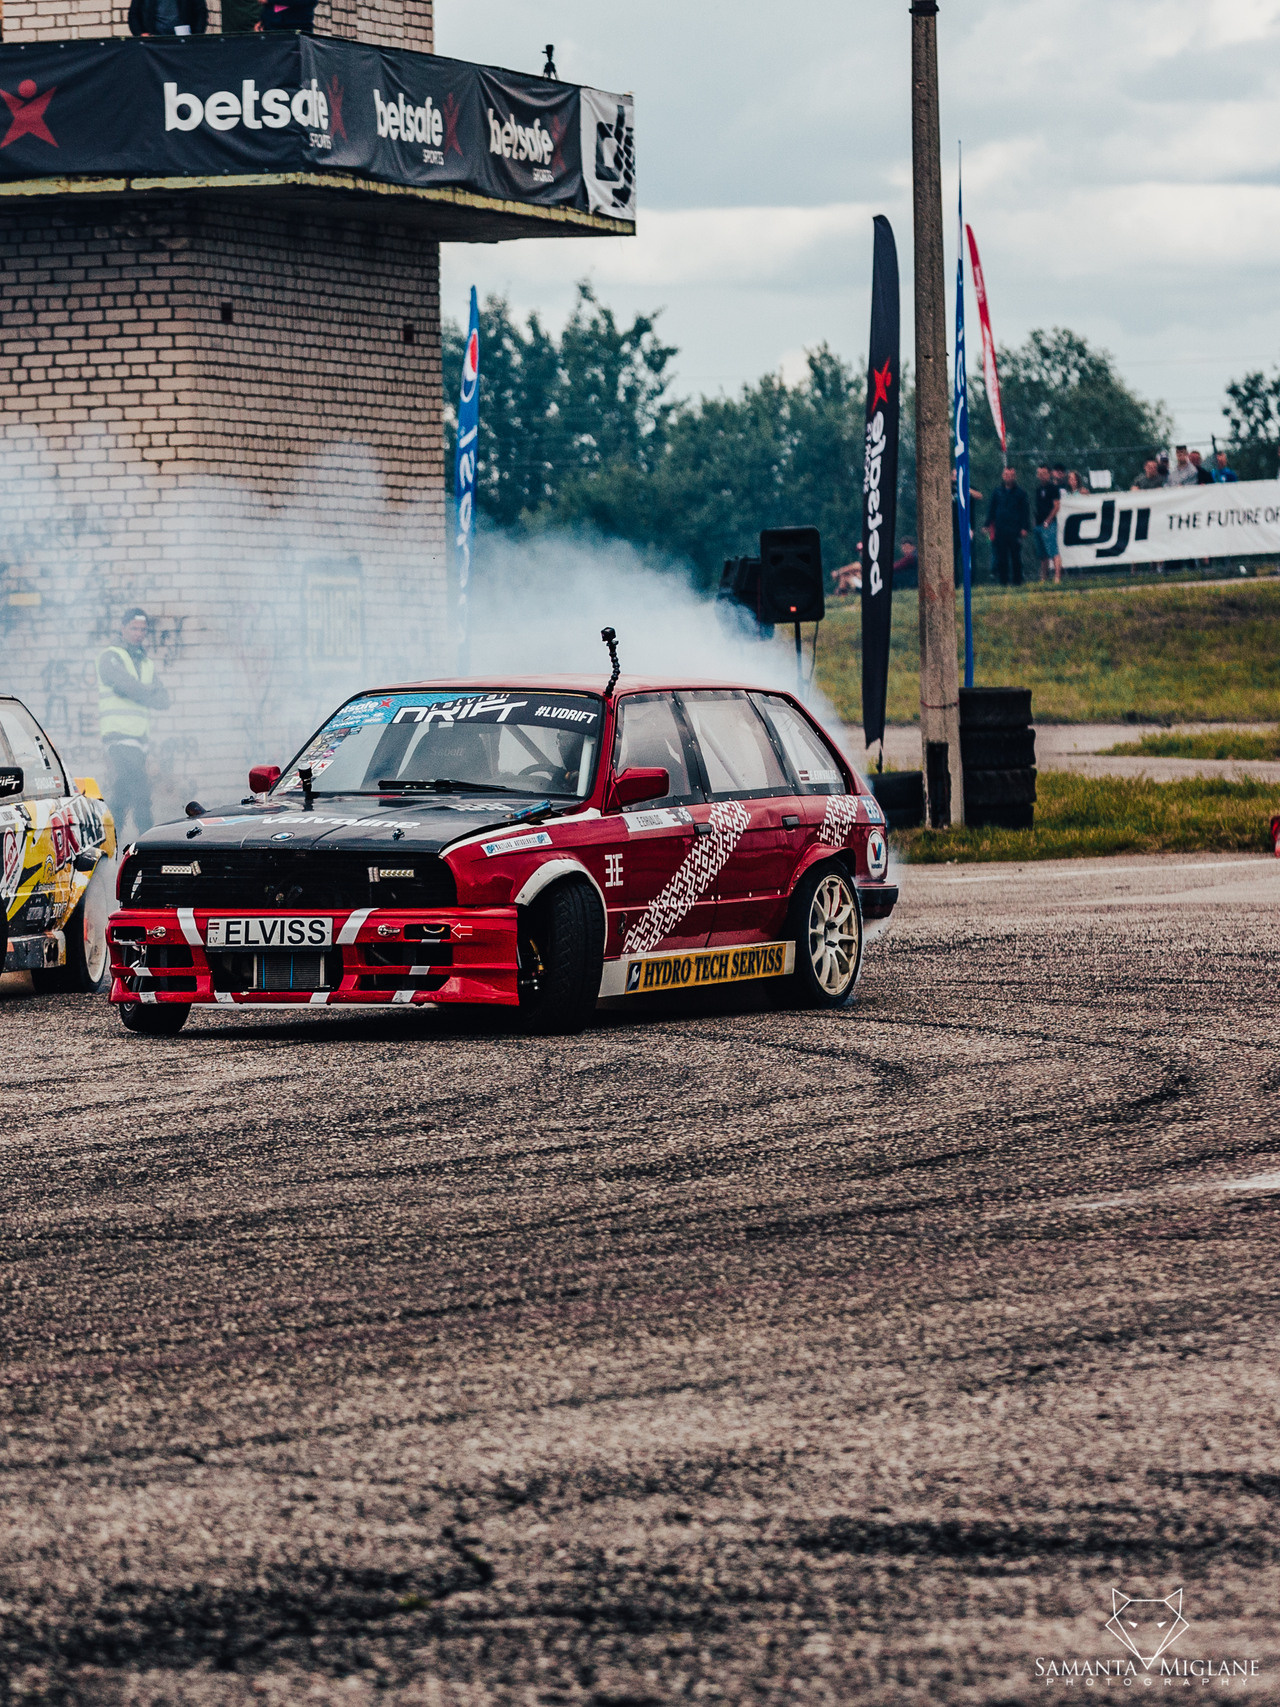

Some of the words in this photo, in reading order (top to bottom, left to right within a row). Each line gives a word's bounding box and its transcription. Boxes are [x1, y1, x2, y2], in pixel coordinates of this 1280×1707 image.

[163, 79, 329, 132] betsafe
[373, 89, 443, 146] betsafe
[488, 108, 554, 165] betsafe
[1168, 512, 1203, 530] THE
[1207, 508, 1261, 528] FUTURE
[535, 705, 597, 724] #LVDRIFT
[262, 816, 420, 829] Valvoline
[225, 919, 326, 945] ELVISS
[643, 958, 691, 988] HYDRO
[694, 953, 728, 982] TECH
[731, 946, 783, 977] SERVISS
